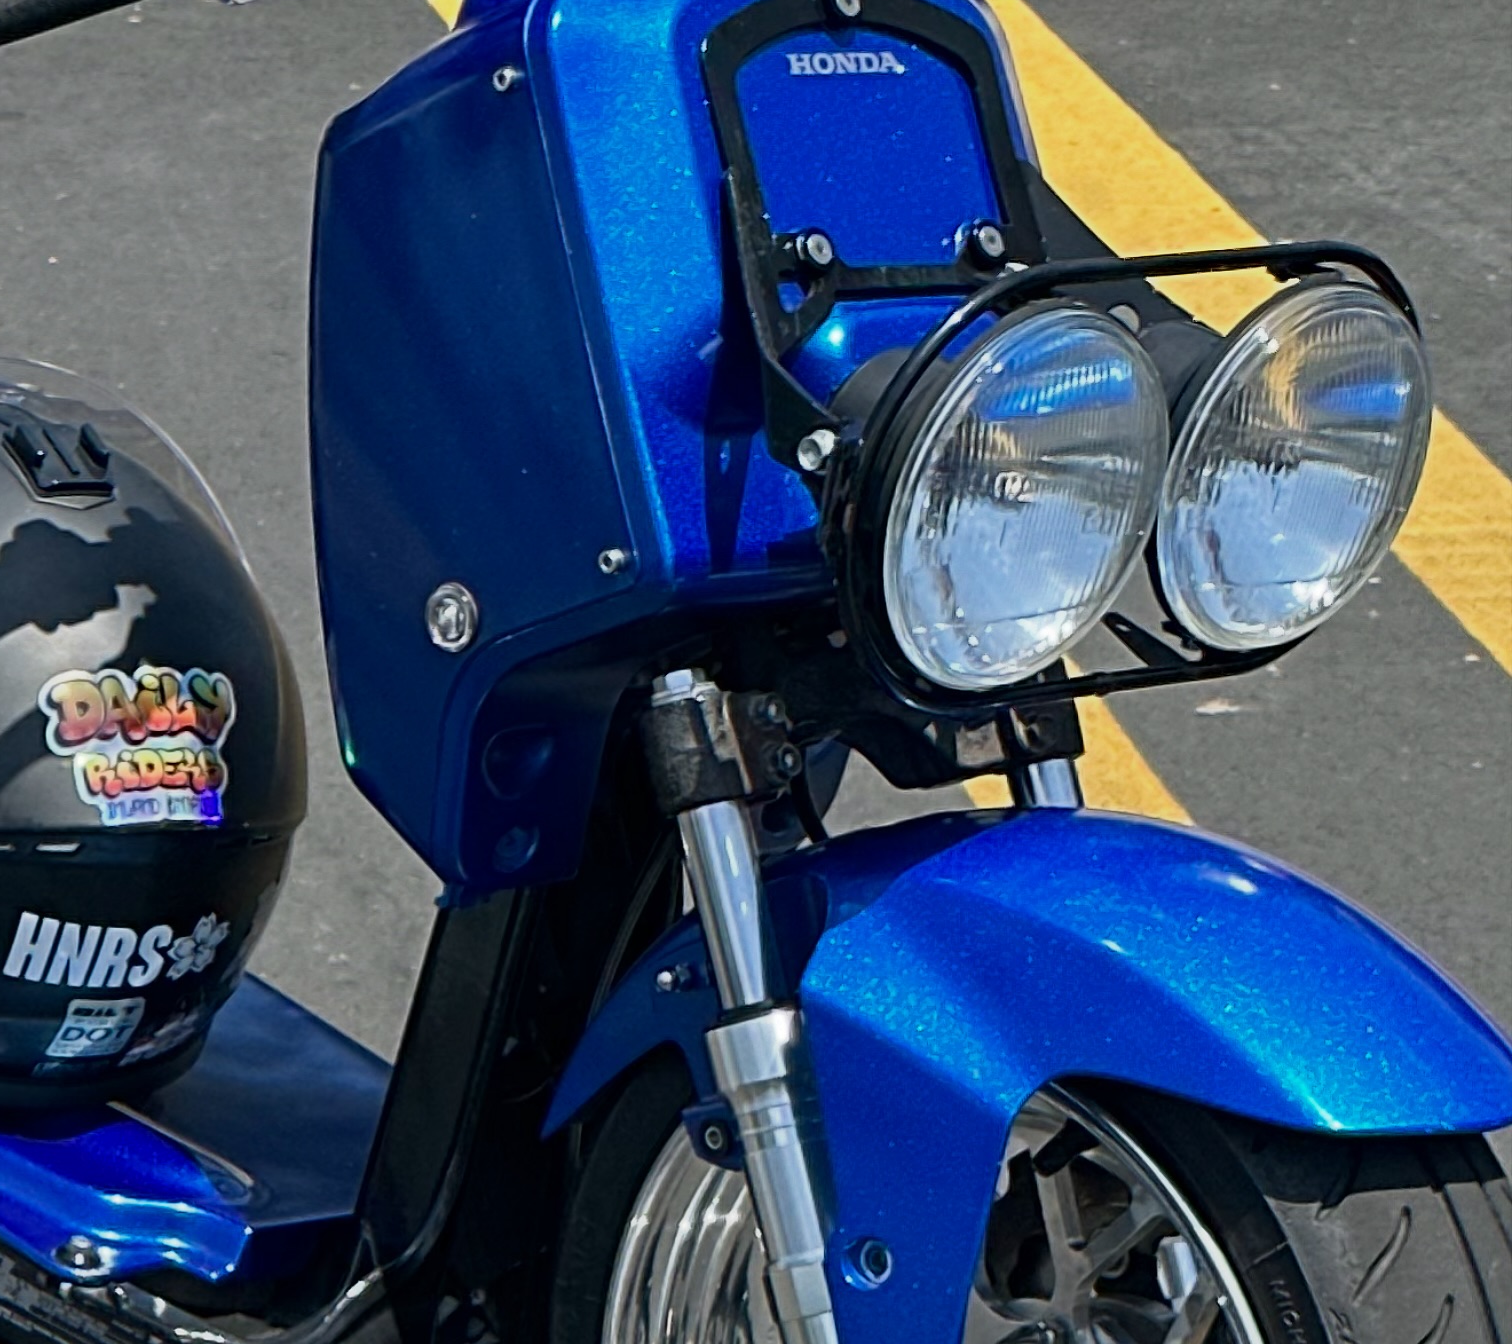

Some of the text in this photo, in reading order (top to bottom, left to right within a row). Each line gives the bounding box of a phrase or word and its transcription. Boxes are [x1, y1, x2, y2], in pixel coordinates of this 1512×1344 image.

[786, 51, 903, 76] HONDA
[2, 911, 173, 988] HNRS
[60, 1024, 135, 1042] DOT
